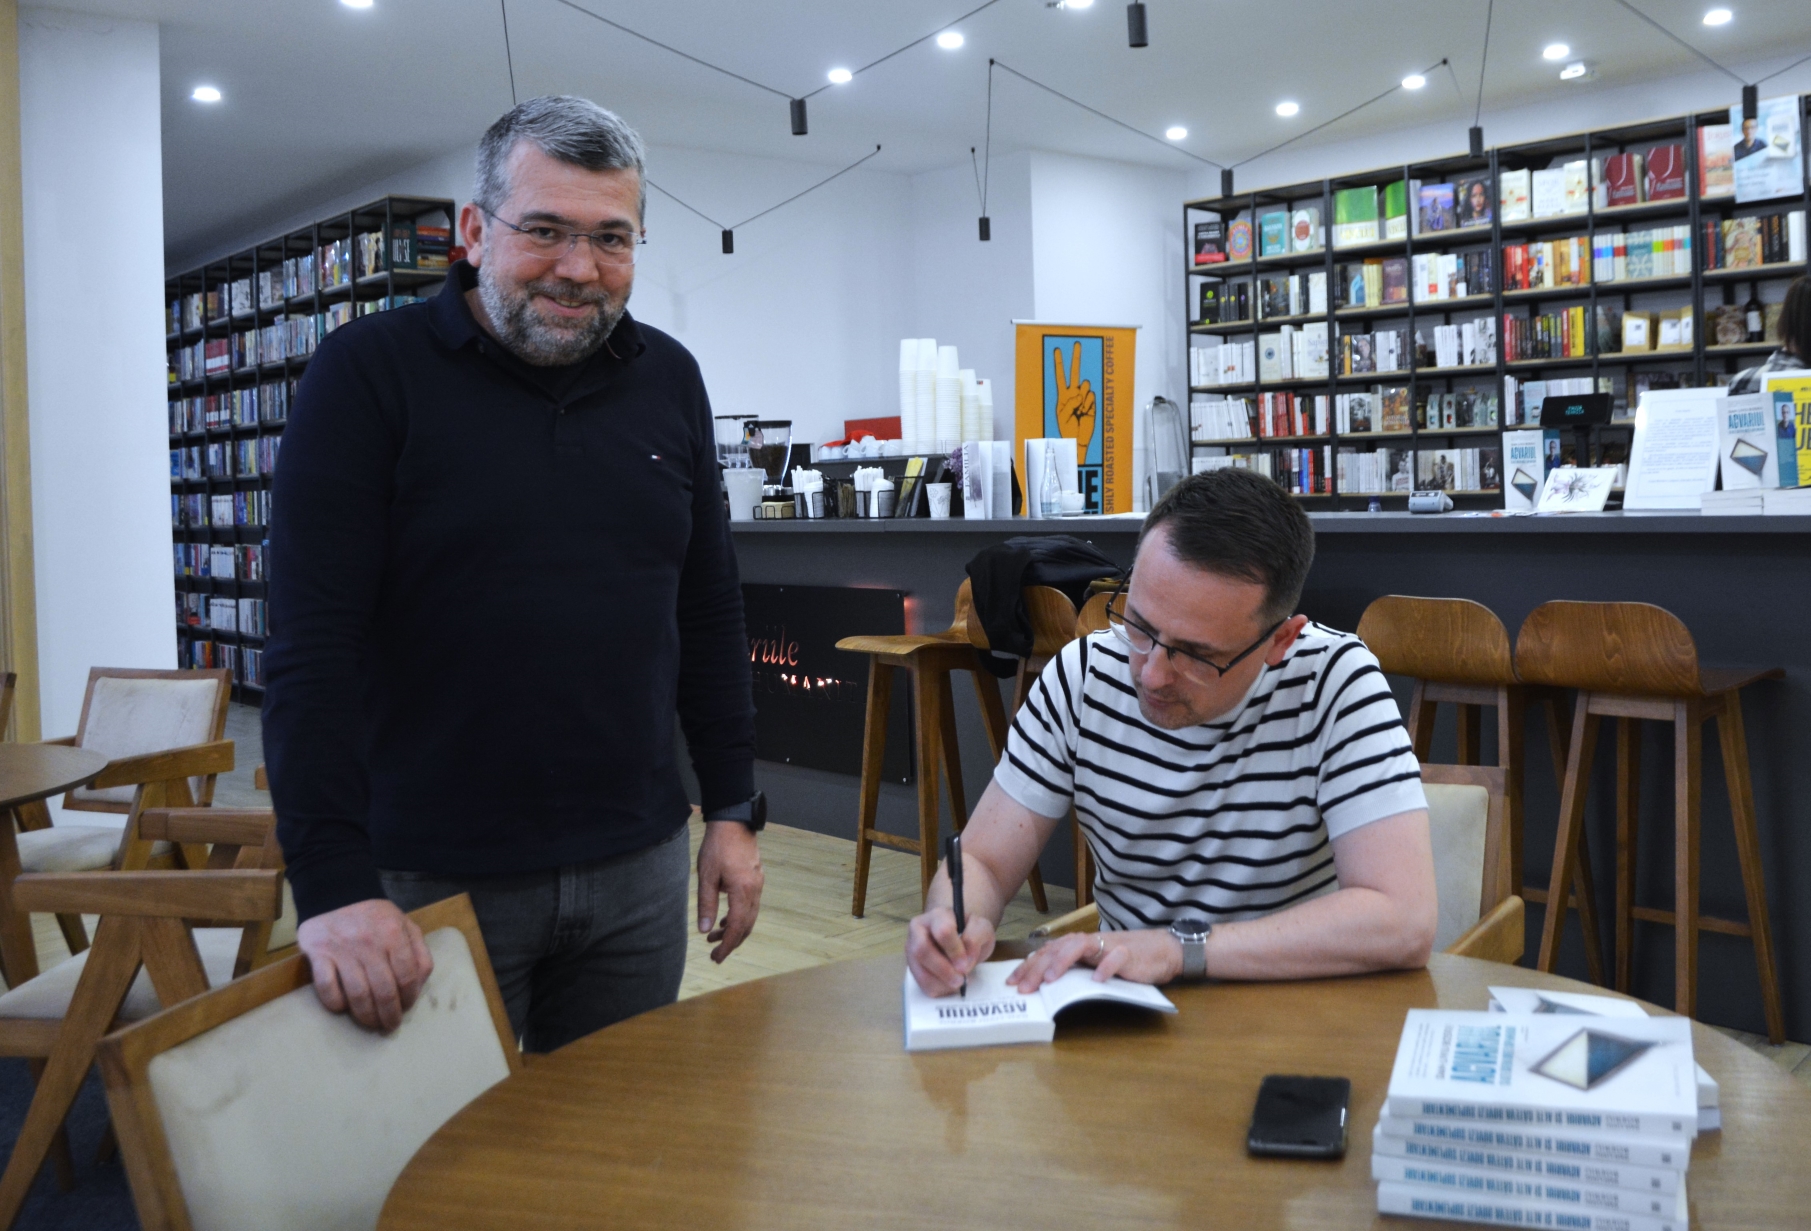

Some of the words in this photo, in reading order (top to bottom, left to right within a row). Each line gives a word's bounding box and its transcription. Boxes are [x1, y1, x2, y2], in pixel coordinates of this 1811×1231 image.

[1105, 336, 1115, 376] COFFEE
[1105, 378, 1115, 433] SPECIALTY
[963, 444, 971, 488] FAMILIA
[1105, 436, 1115, 485] ROASTED
[748, 624, 800, 667] riile
